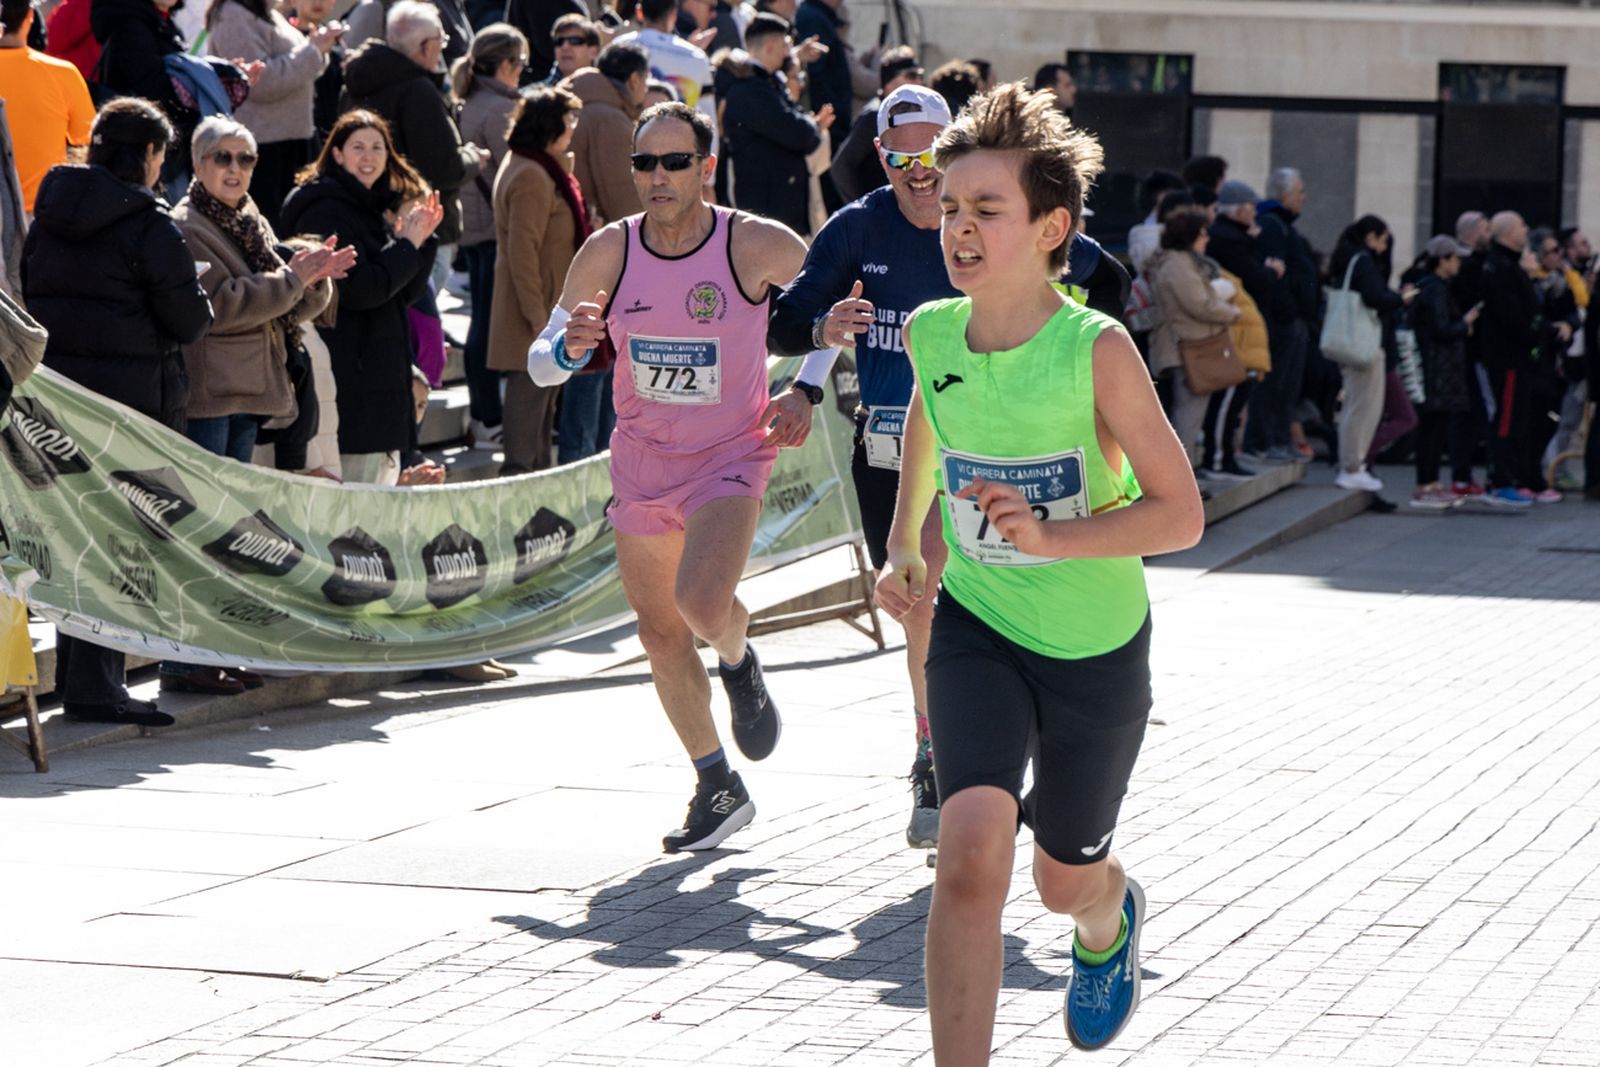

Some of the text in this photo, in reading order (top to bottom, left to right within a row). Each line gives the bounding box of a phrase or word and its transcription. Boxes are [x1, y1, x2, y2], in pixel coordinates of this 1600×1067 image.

[862, 262, 888, 275] vive
[638, 351, 692, 364] BUENA MUERTE
[648, 366, 697, 390] 772
[956, 463, 1064, 480] VI CARRERA CAMINATA
[228, 531, 295, 567] ownat
[343, 551, 387, 583] ownat
[433, 546, 479, 581] ownat
